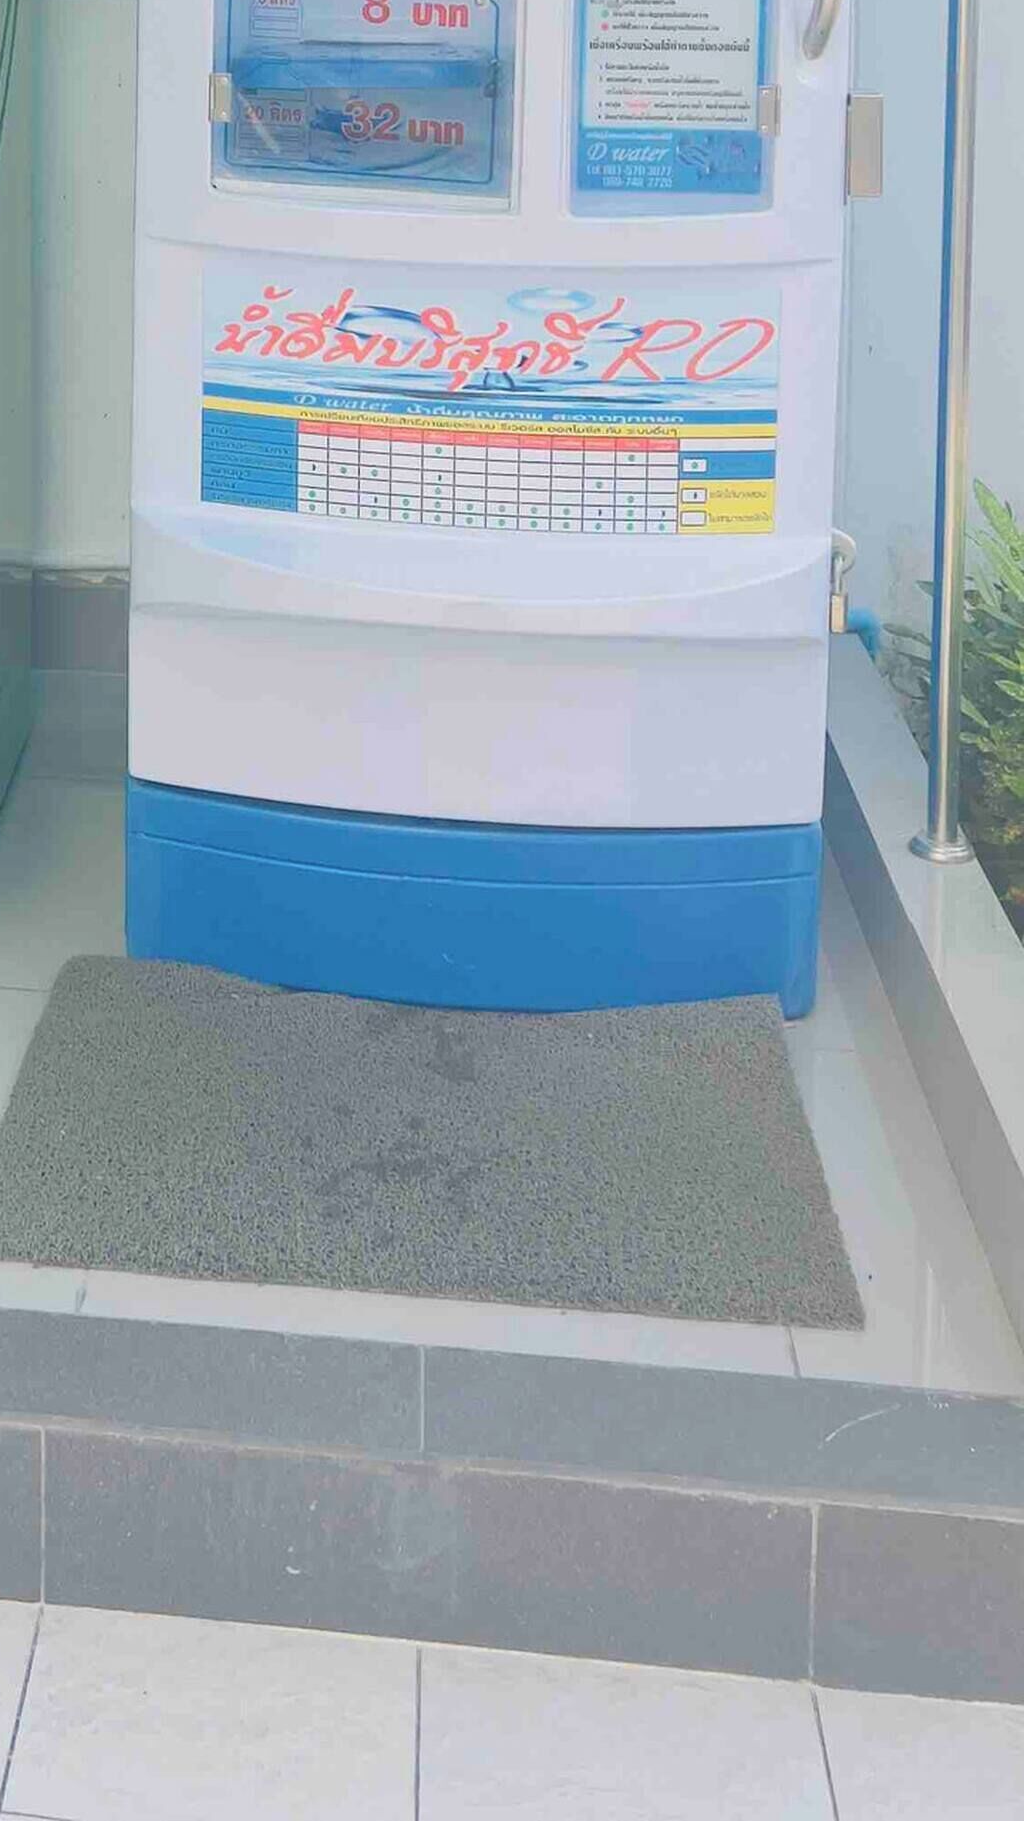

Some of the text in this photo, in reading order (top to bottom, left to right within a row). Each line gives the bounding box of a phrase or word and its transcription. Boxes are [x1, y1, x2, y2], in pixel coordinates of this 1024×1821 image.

[412, 1, 469, 28] บาท
[269, 101, 305, 122] ลิตร
[342, 100, 465, 146] 32 บาท
[612, 145, 671, 162] water
[214, 286, 775, 392] น้ำดื่มบริสุทธิ์ RO
[326, 398, 392, 411] water
